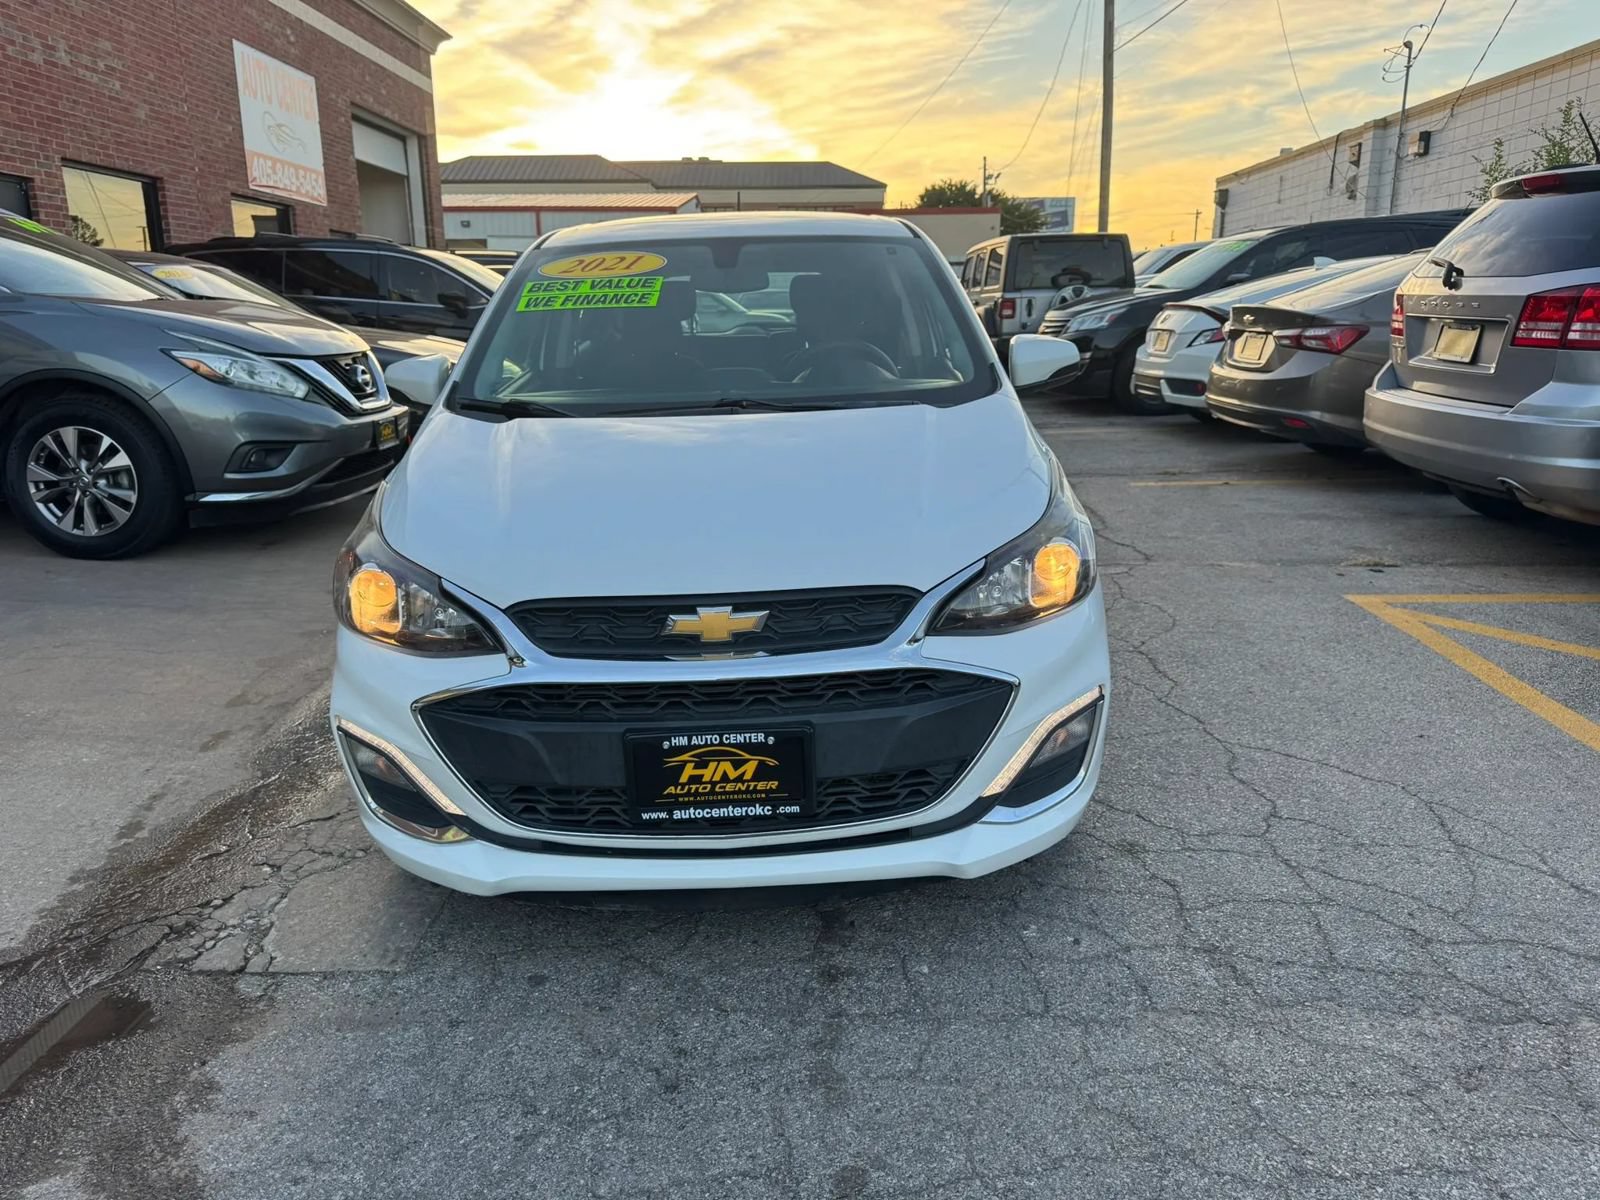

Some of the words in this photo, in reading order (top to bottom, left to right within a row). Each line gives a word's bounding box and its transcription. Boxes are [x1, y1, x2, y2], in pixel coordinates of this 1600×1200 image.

[241, 51, 272, 104] AUTO
[275, 69, 316, 121] CENTER
[252, 154, 323, 197] 405-849-5454
[558, 255, 646, 274] 2021
[528, 280, 585, 293] BEST
[590, 278, 656, 290] VALUE
[524, 296, 559, 309] WE
[560, 293, 651, 306] FINANCE
[671, 736, 688, 747] HM
[691, 735, 720, 746] AUTO
[723, 733, 766, 744] CENTER
[679, 760, 759, 783] HM
[663, 784, 711, 795] AUTO
[715, 781, 779, 792] CENTER
[641, 811, 669, 820] www.
[673, 803, 772, 820] autocenterokc
[776, 804, 800, 815] .com
